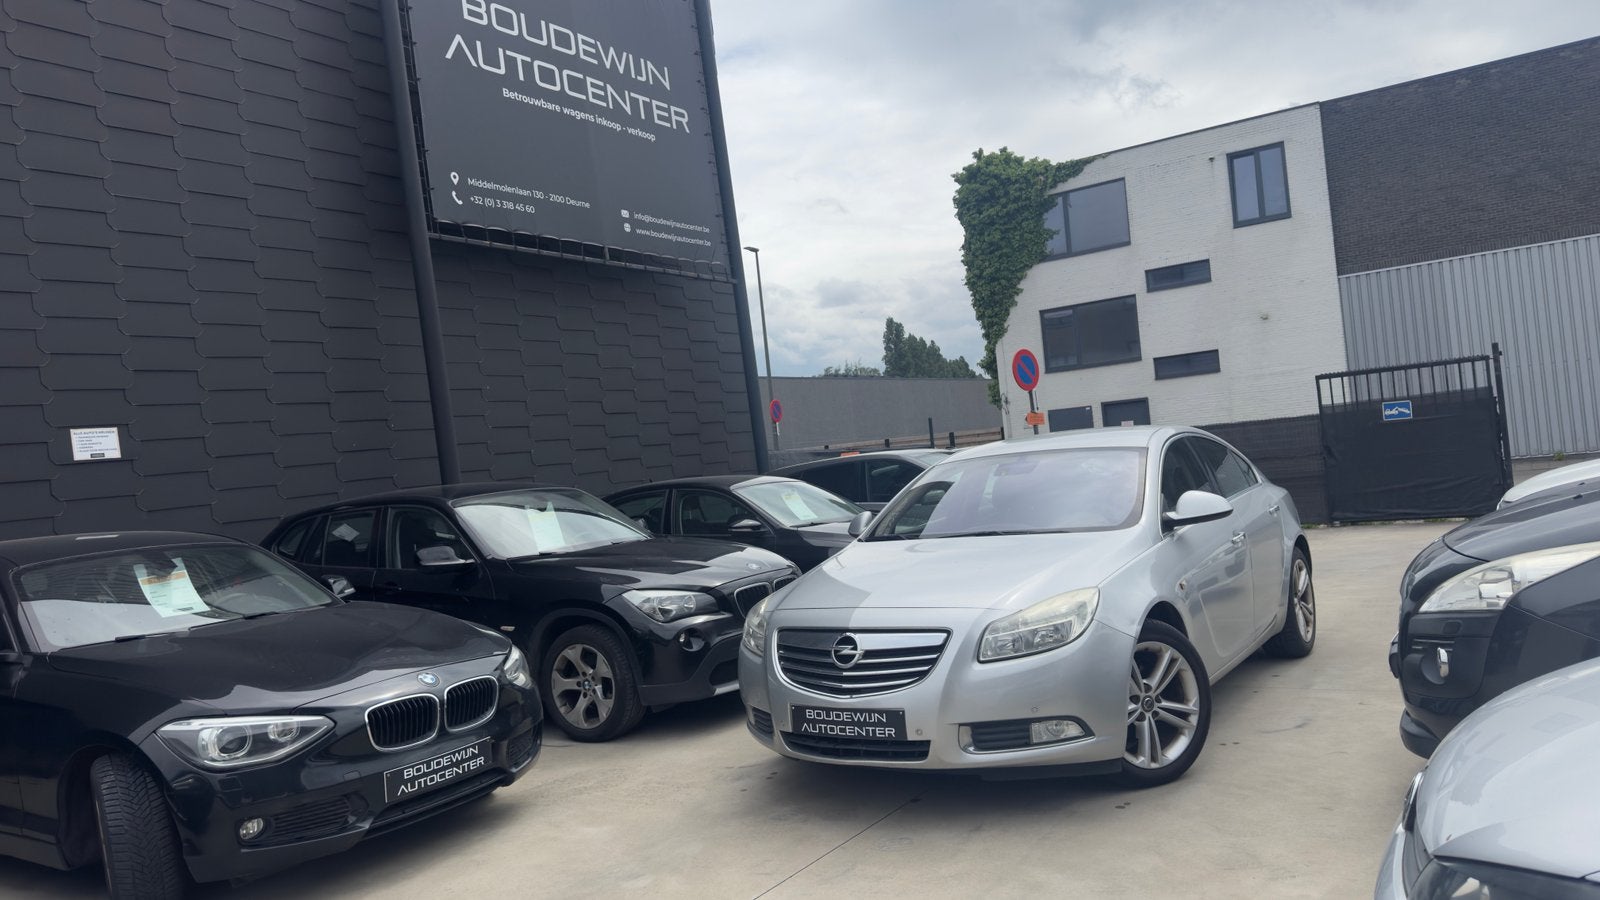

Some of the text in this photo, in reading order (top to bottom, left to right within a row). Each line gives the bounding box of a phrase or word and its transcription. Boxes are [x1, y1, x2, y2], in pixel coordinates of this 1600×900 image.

[462, 0, 671, 91] BOUDEWIJN
[445, 34, 690, 133] AUTOCENTER
[502, 87, 561, 113] Betrouwbare
[562, 106, 595, 123] wagens
[595, 115, 622, 132] inkoop
[626, 126, 656, 142] verkoop
[467, 177, 532, 197] Middelmolenlaan
[533, 190, 544, 200] 130
[549, 193, 565, 204] 2100
[566, 196, 591, 208] Deurne
[470, 195, 535, 214] +32 (0) 3 318 45 60
[633, 212, 710, 233] info@boudewijnautocenter.be
[635, 228, 711, 246] www.boudewijnautocenter.be
[801, 723, 896, 738] AUTOCENTER
[805, 709, 887, 723] BOUDEWIJN
[397, 756, 485, 796] AUTOCENTER
[403, 745, 479, 779] BOUDEWIJN
